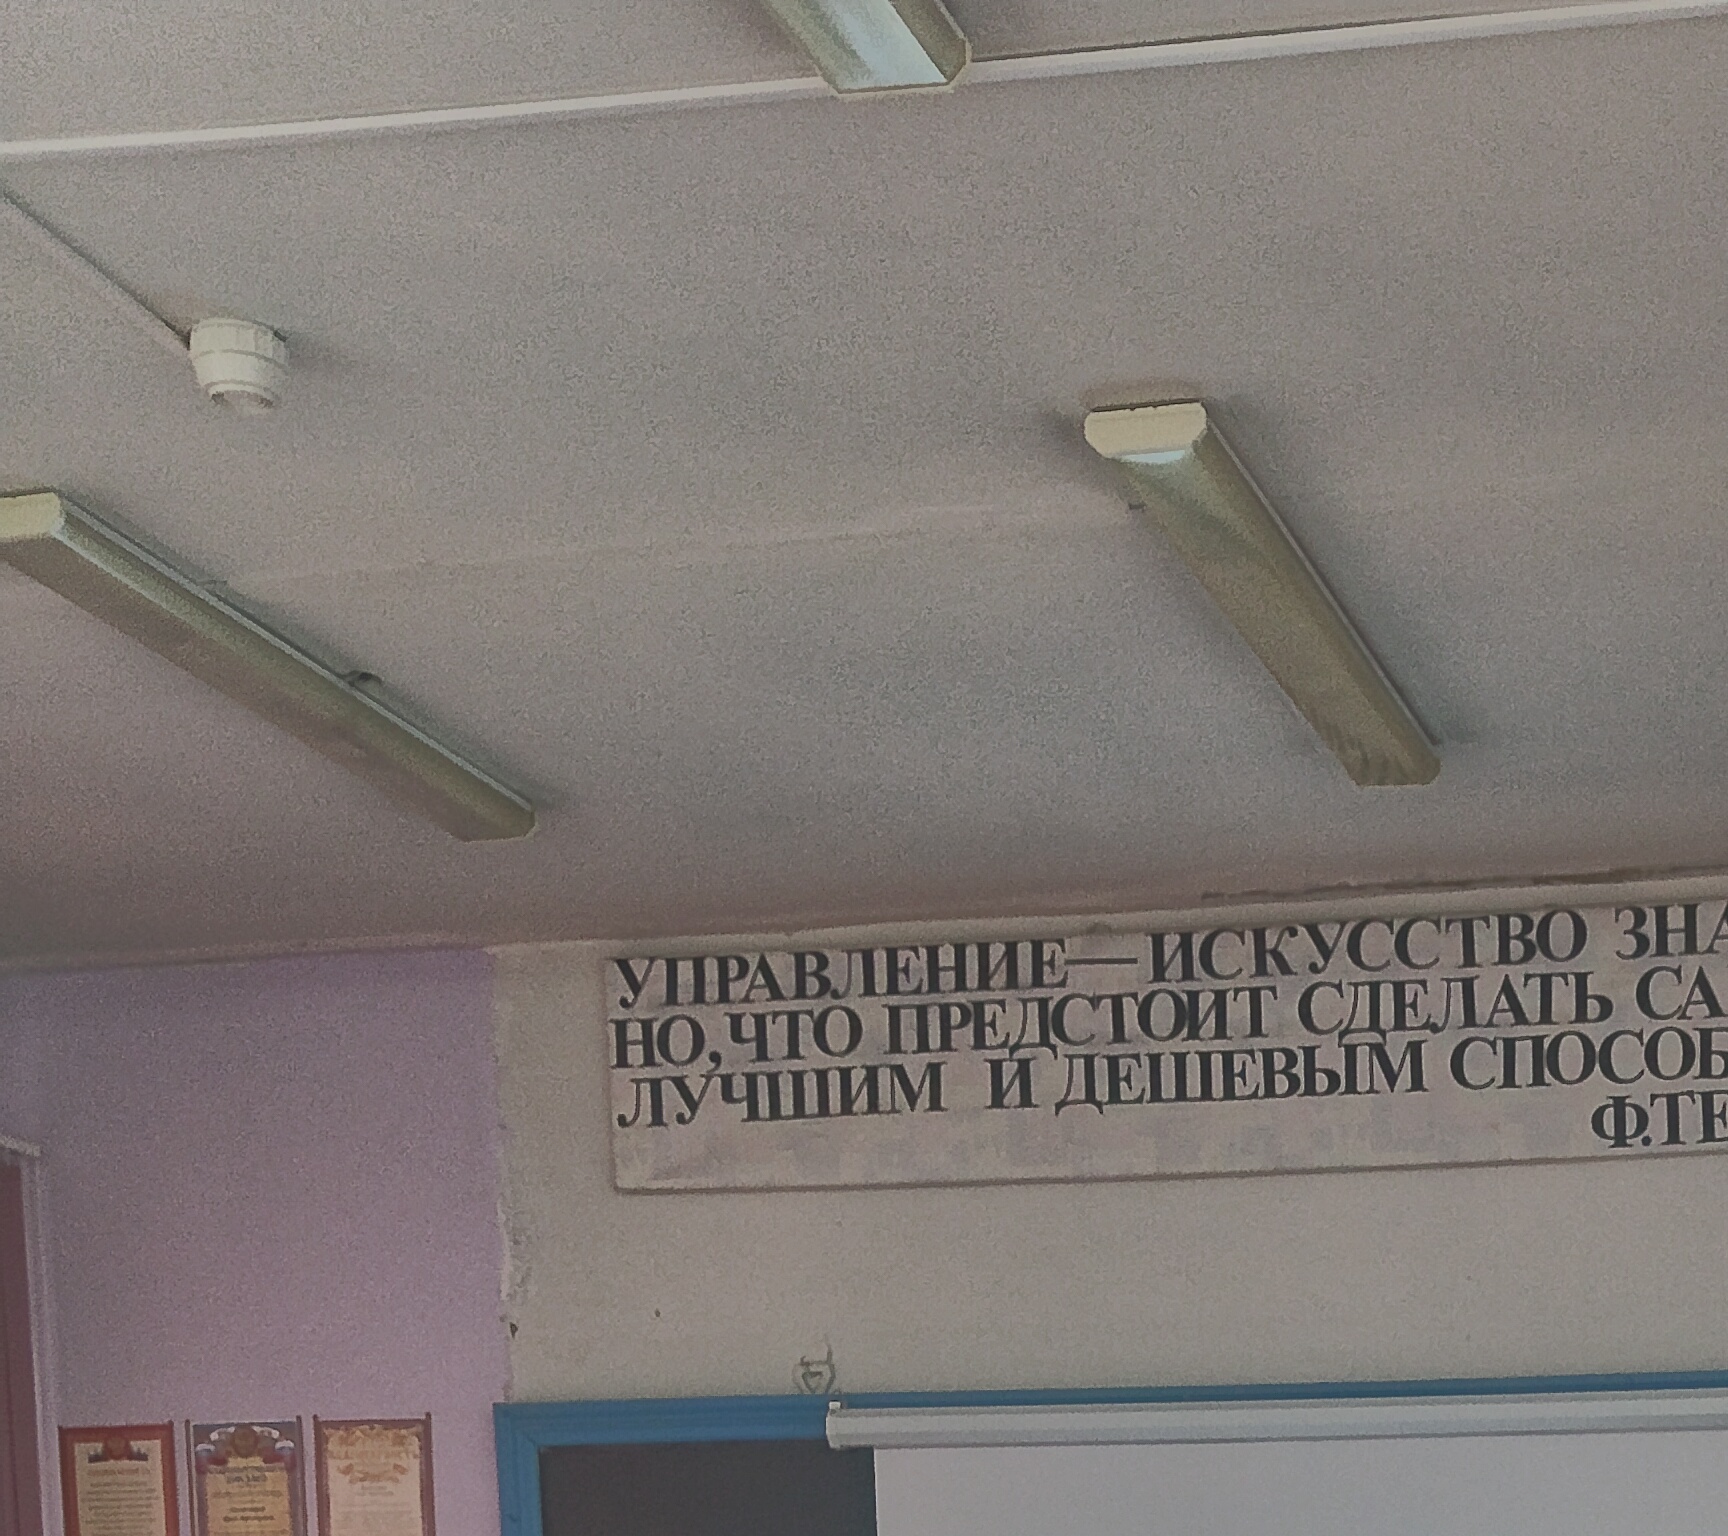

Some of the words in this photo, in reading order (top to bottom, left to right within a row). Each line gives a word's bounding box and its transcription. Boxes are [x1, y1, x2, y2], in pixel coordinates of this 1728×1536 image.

[883, 985, 1278, 1060] ПРЕДСТОИТ
[1298, 970, 1614, 1046] СДЕЛАТЬ
[617, 1061, 948, 1128] ЛУЧШИМ
[984, 1056, 1040, 1109] И
[1055, 1039, 1429, 1115] ДЕШЕВЫМ
